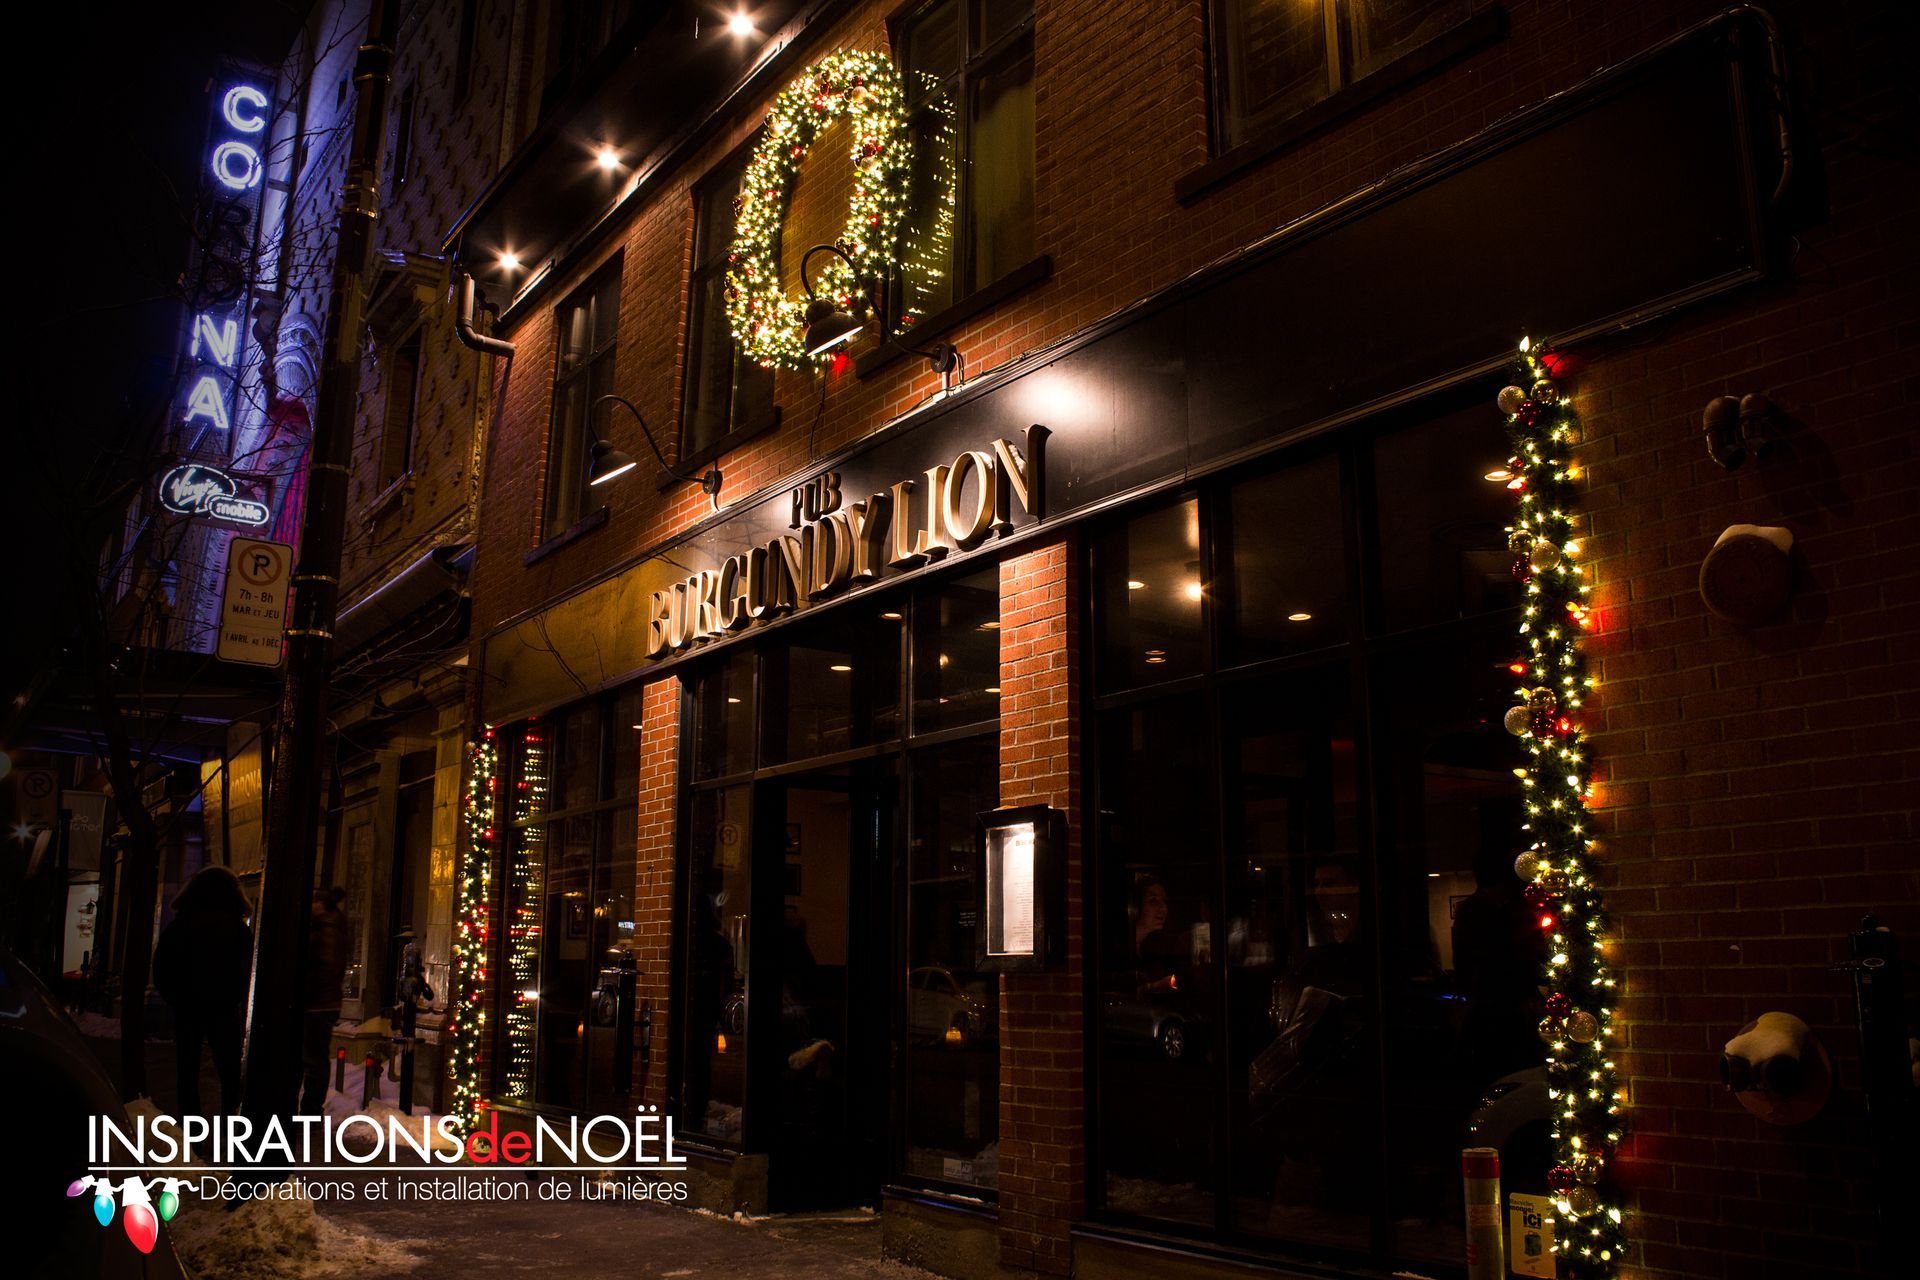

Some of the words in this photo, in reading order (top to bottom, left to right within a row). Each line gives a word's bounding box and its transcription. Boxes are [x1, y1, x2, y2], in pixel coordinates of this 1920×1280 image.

[788, 471, 843, 529] PUB
[215, 502, 262, 521] mobile
[644, 491, 892, 660] BURGUNDY
[888, 423, 1053, 568] LION
[239, 588, 251, 600] 7h
[260, 591, 274, 604] 8h
[232, 604, 251, 615] MAR
[263, 609, 280, 619] JEU
[229, 633, 249, 644] AVRIL
